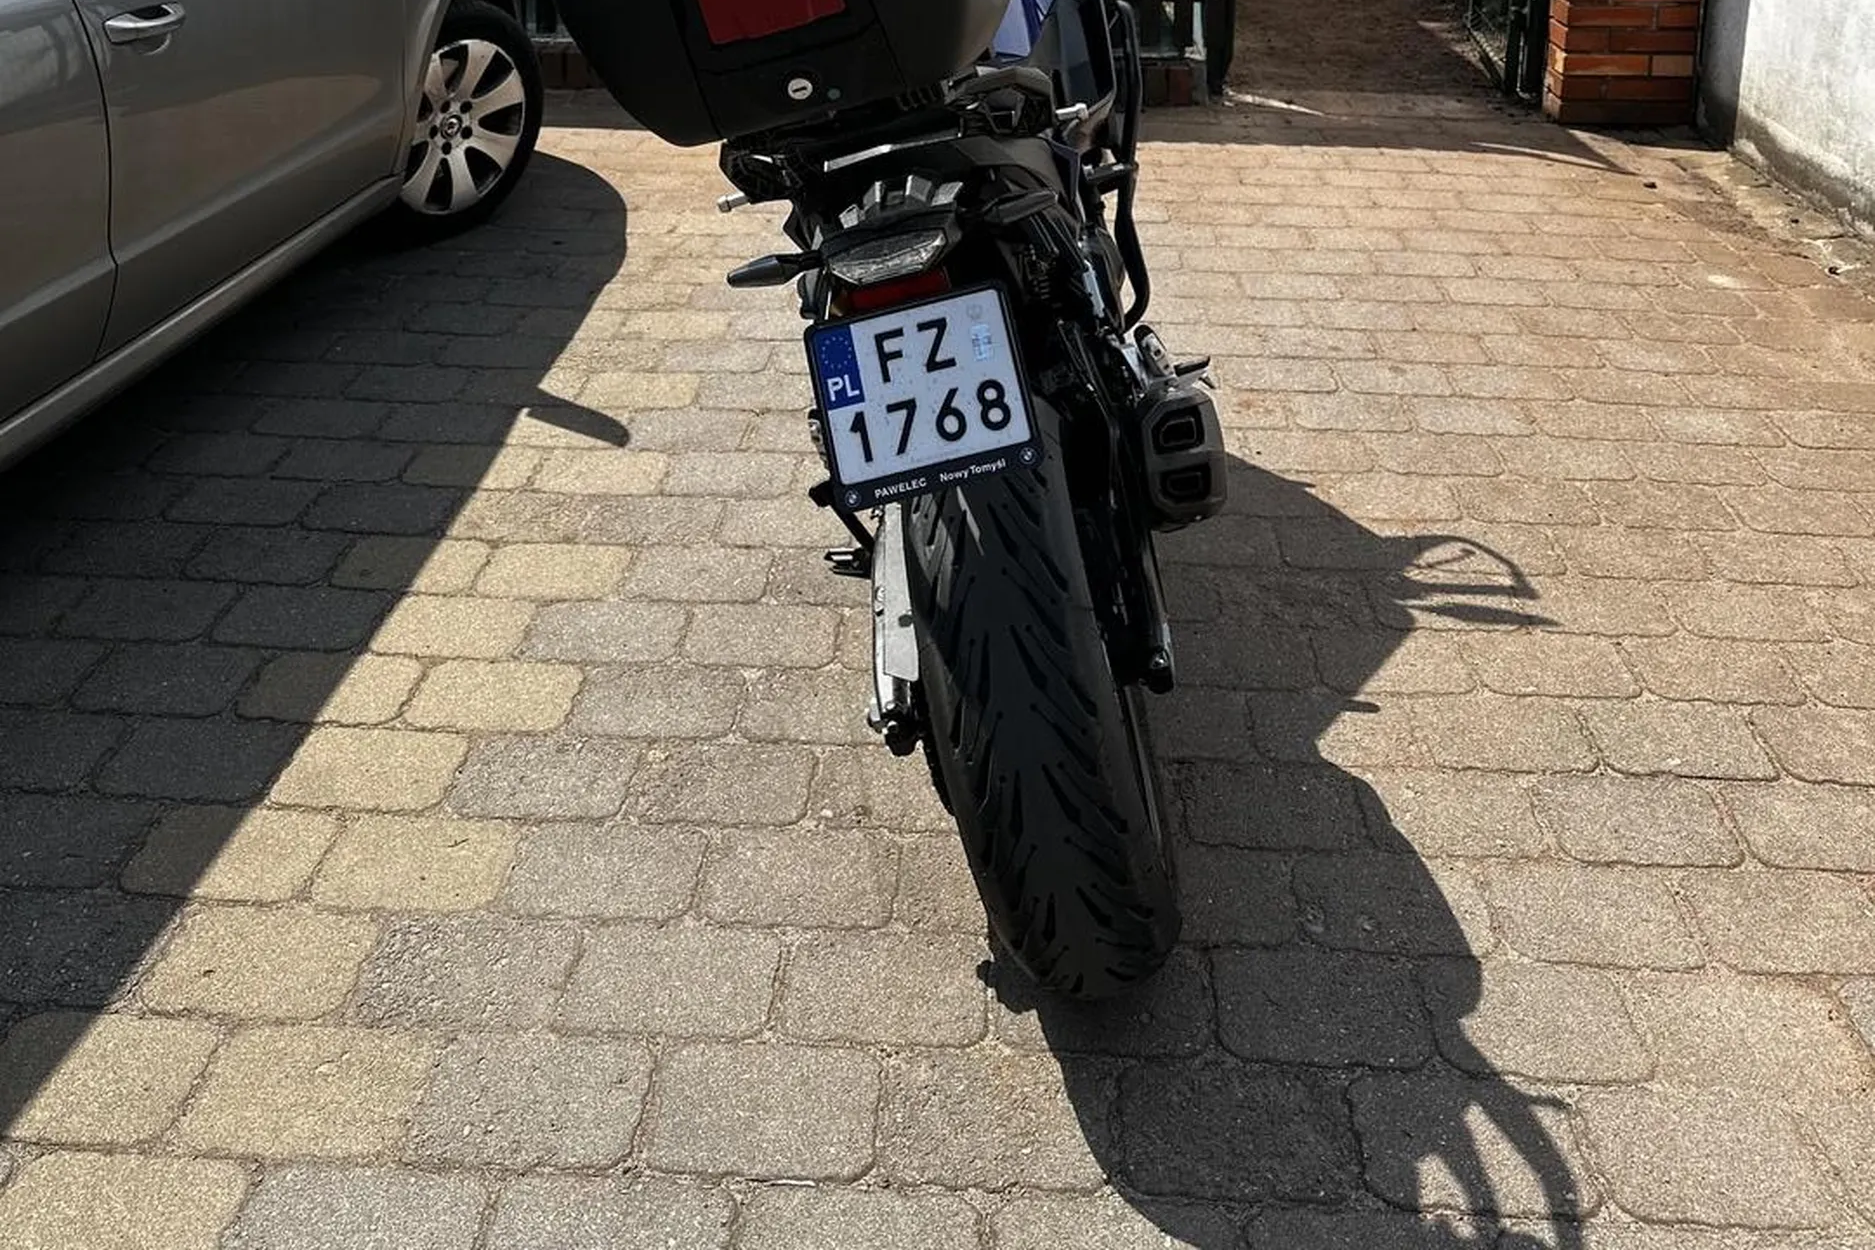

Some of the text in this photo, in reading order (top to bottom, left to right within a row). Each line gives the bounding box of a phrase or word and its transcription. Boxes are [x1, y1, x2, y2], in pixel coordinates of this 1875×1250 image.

[873, 317, 957, 383] FZ
[826, 374, 860, 402] PL
[850, 379, 1011, 463] 1768
[874, 477, 927, 499] PAWELEC
